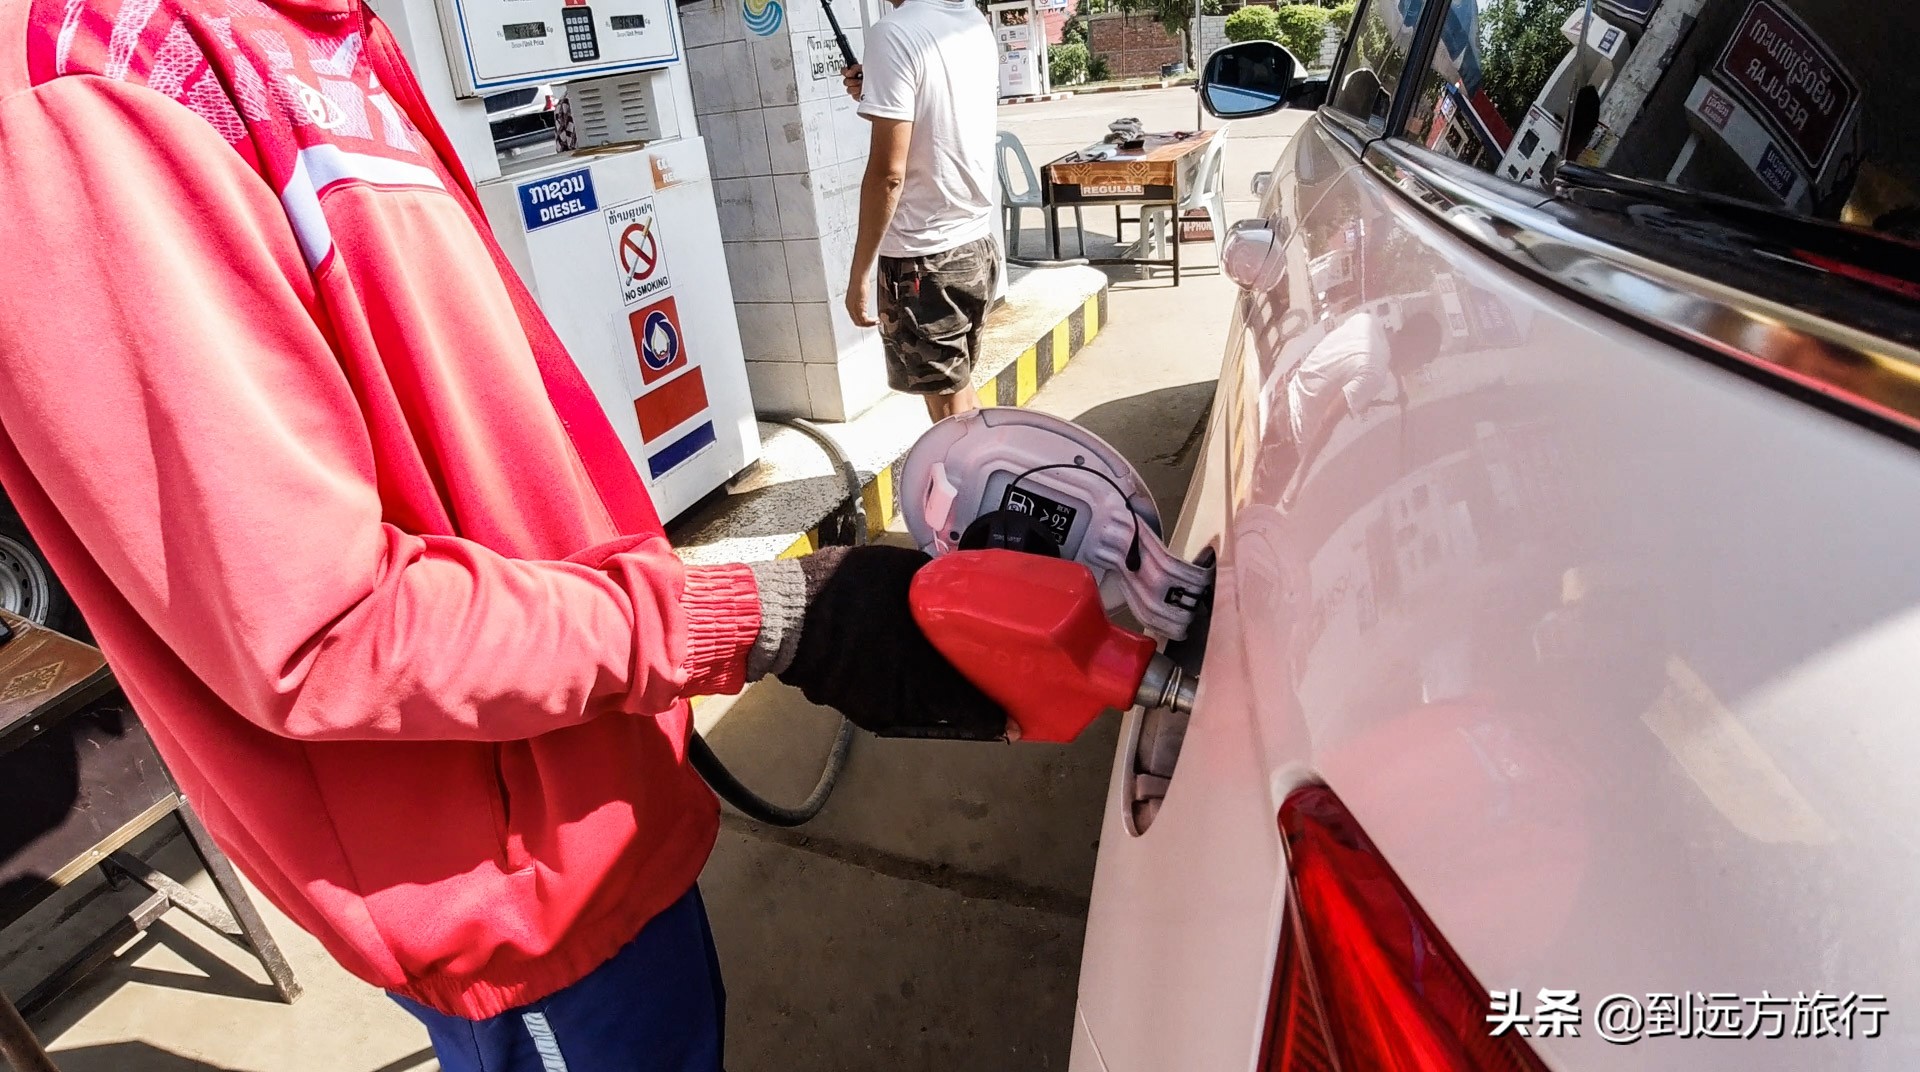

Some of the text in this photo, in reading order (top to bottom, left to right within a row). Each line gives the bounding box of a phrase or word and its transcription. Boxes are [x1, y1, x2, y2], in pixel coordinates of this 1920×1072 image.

[1083, 184, 1142, 194] REGULAR
[540, 198, 586, 222] DIESEL
[625, 276, 668, 301] NO SMOKING
